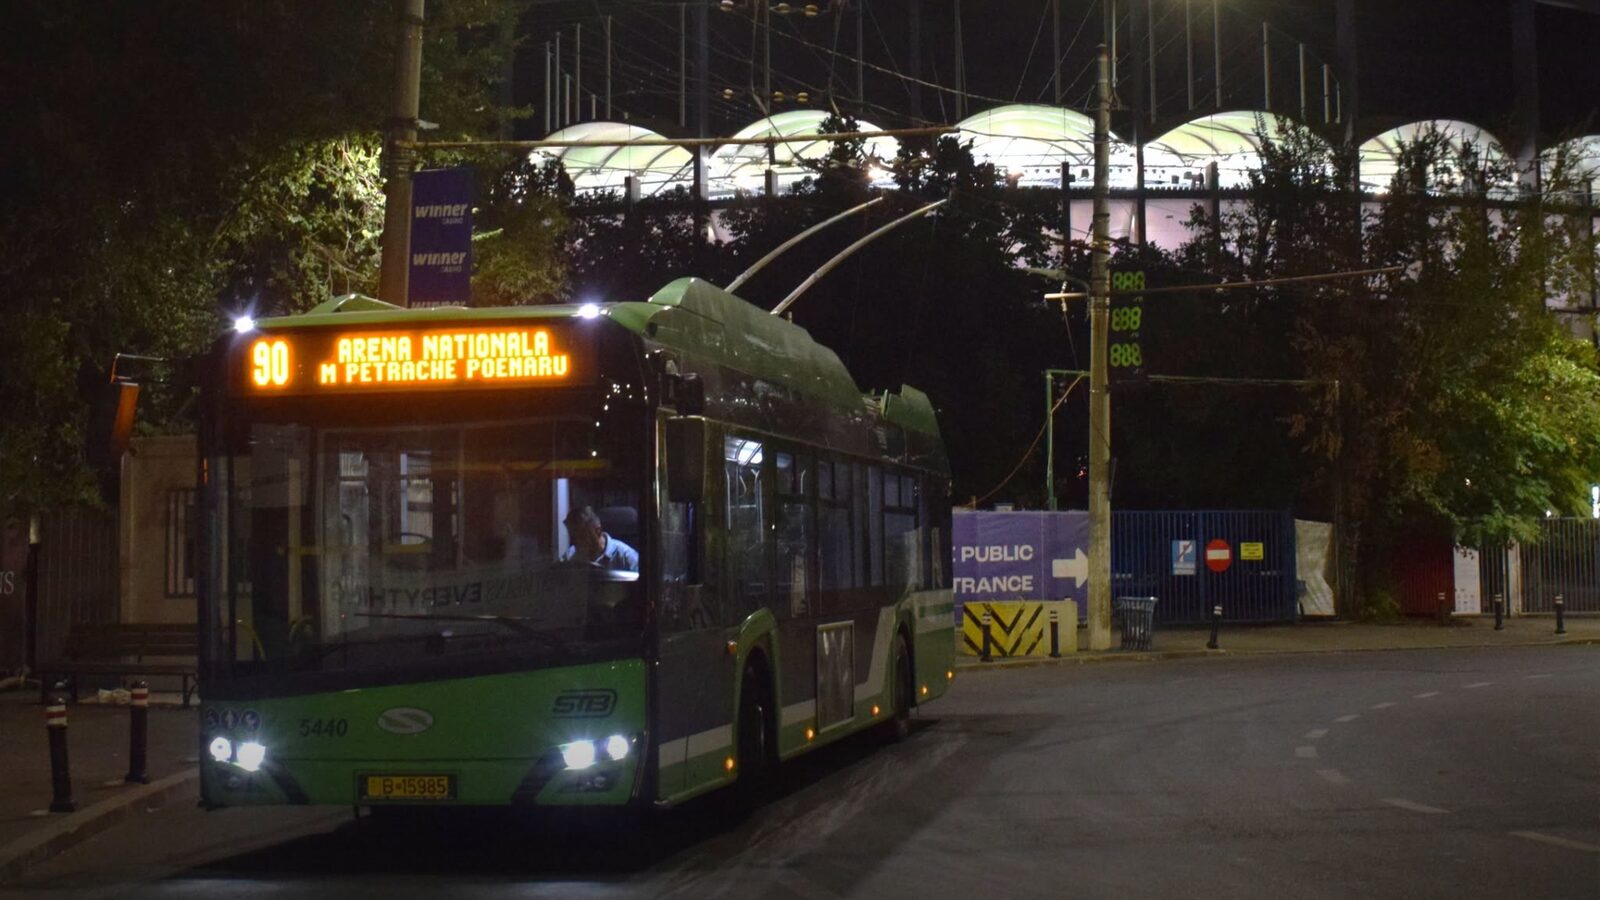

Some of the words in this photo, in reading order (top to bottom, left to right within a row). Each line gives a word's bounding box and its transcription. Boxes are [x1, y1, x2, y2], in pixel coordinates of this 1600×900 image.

[415, 203, 468, 218] winner
[412, 252, 467, 266] winner
[1111, 305, 1142, 331] 888
[337, 336, 412, 363] ARENA
[422, 331, 549, 360] NATIONALA
[1110, 342, 1142, 368] 888
[253, 341, 289, 385] 90
[346, 359, 457, 383] PETRACHE
[961, 544, 1033, 562] PUBLIC
[300, 718, 348, 737] 5440
